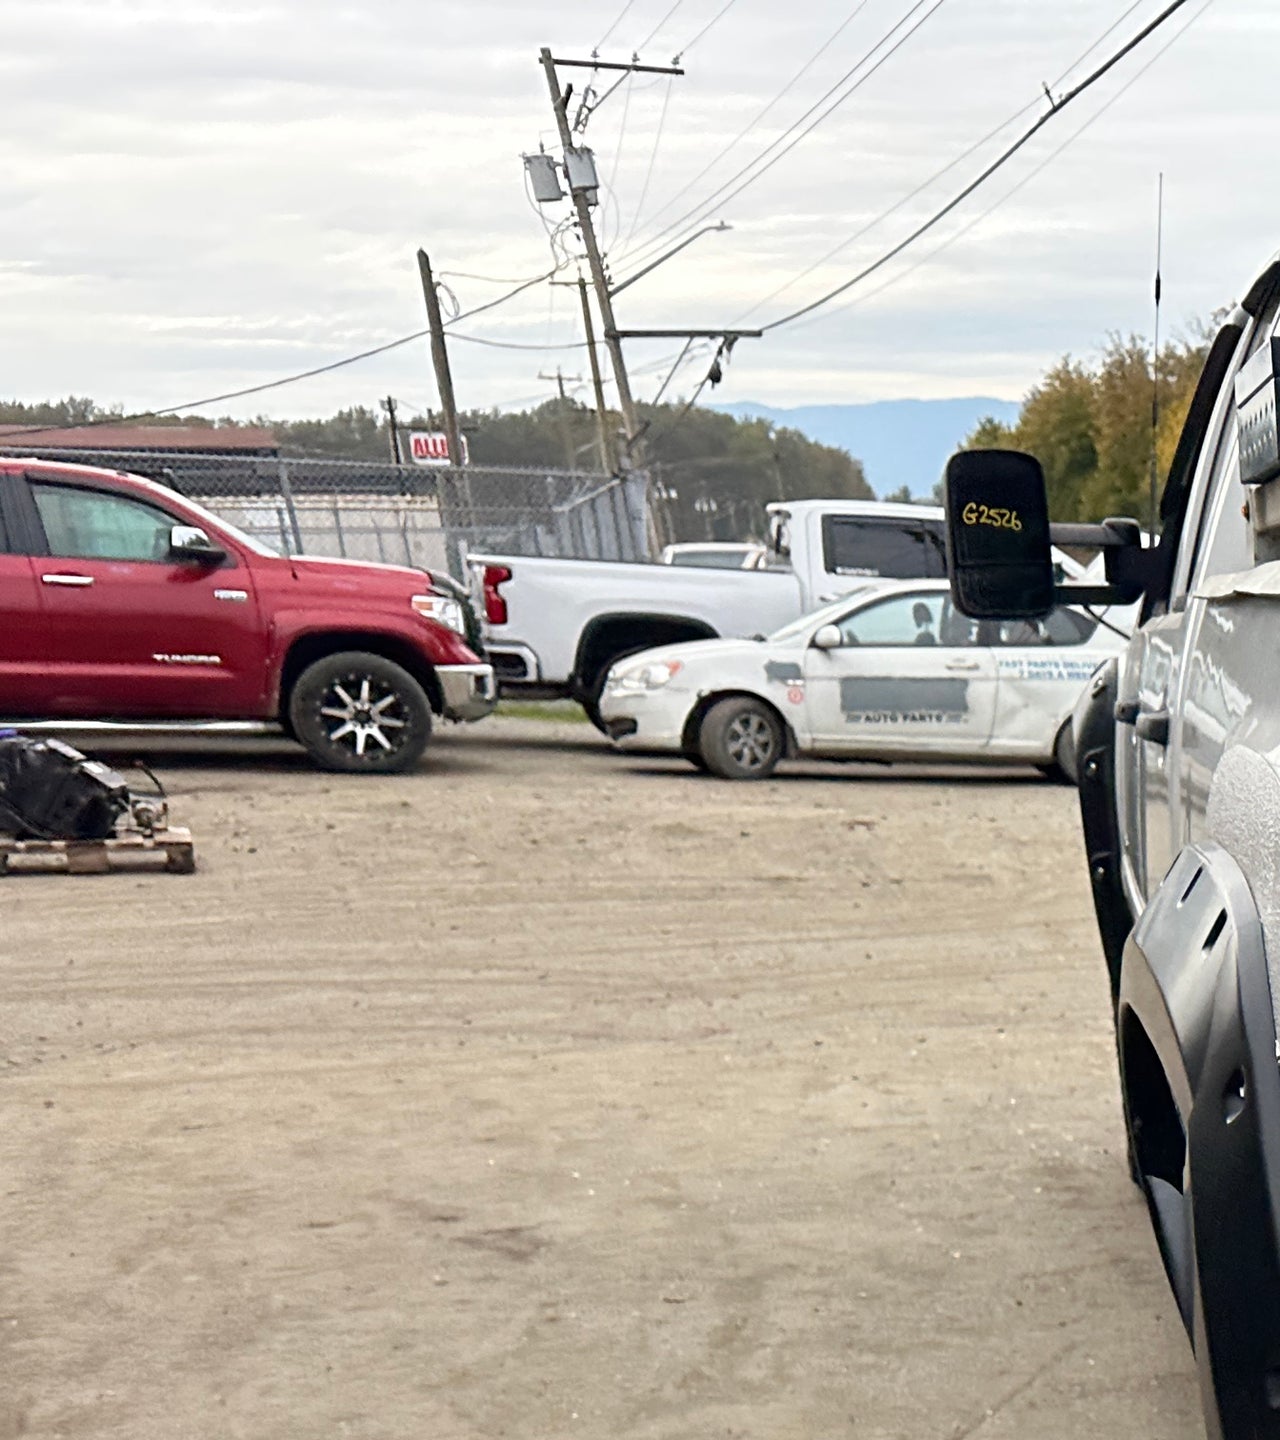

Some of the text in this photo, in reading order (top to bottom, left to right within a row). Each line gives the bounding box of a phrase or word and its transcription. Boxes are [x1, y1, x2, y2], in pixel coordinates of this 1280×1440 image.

[962, 502, 1022, 531] G2526
[864, 713, 898, 722] AUTO
[902, 713, 943, 722] PARTS
